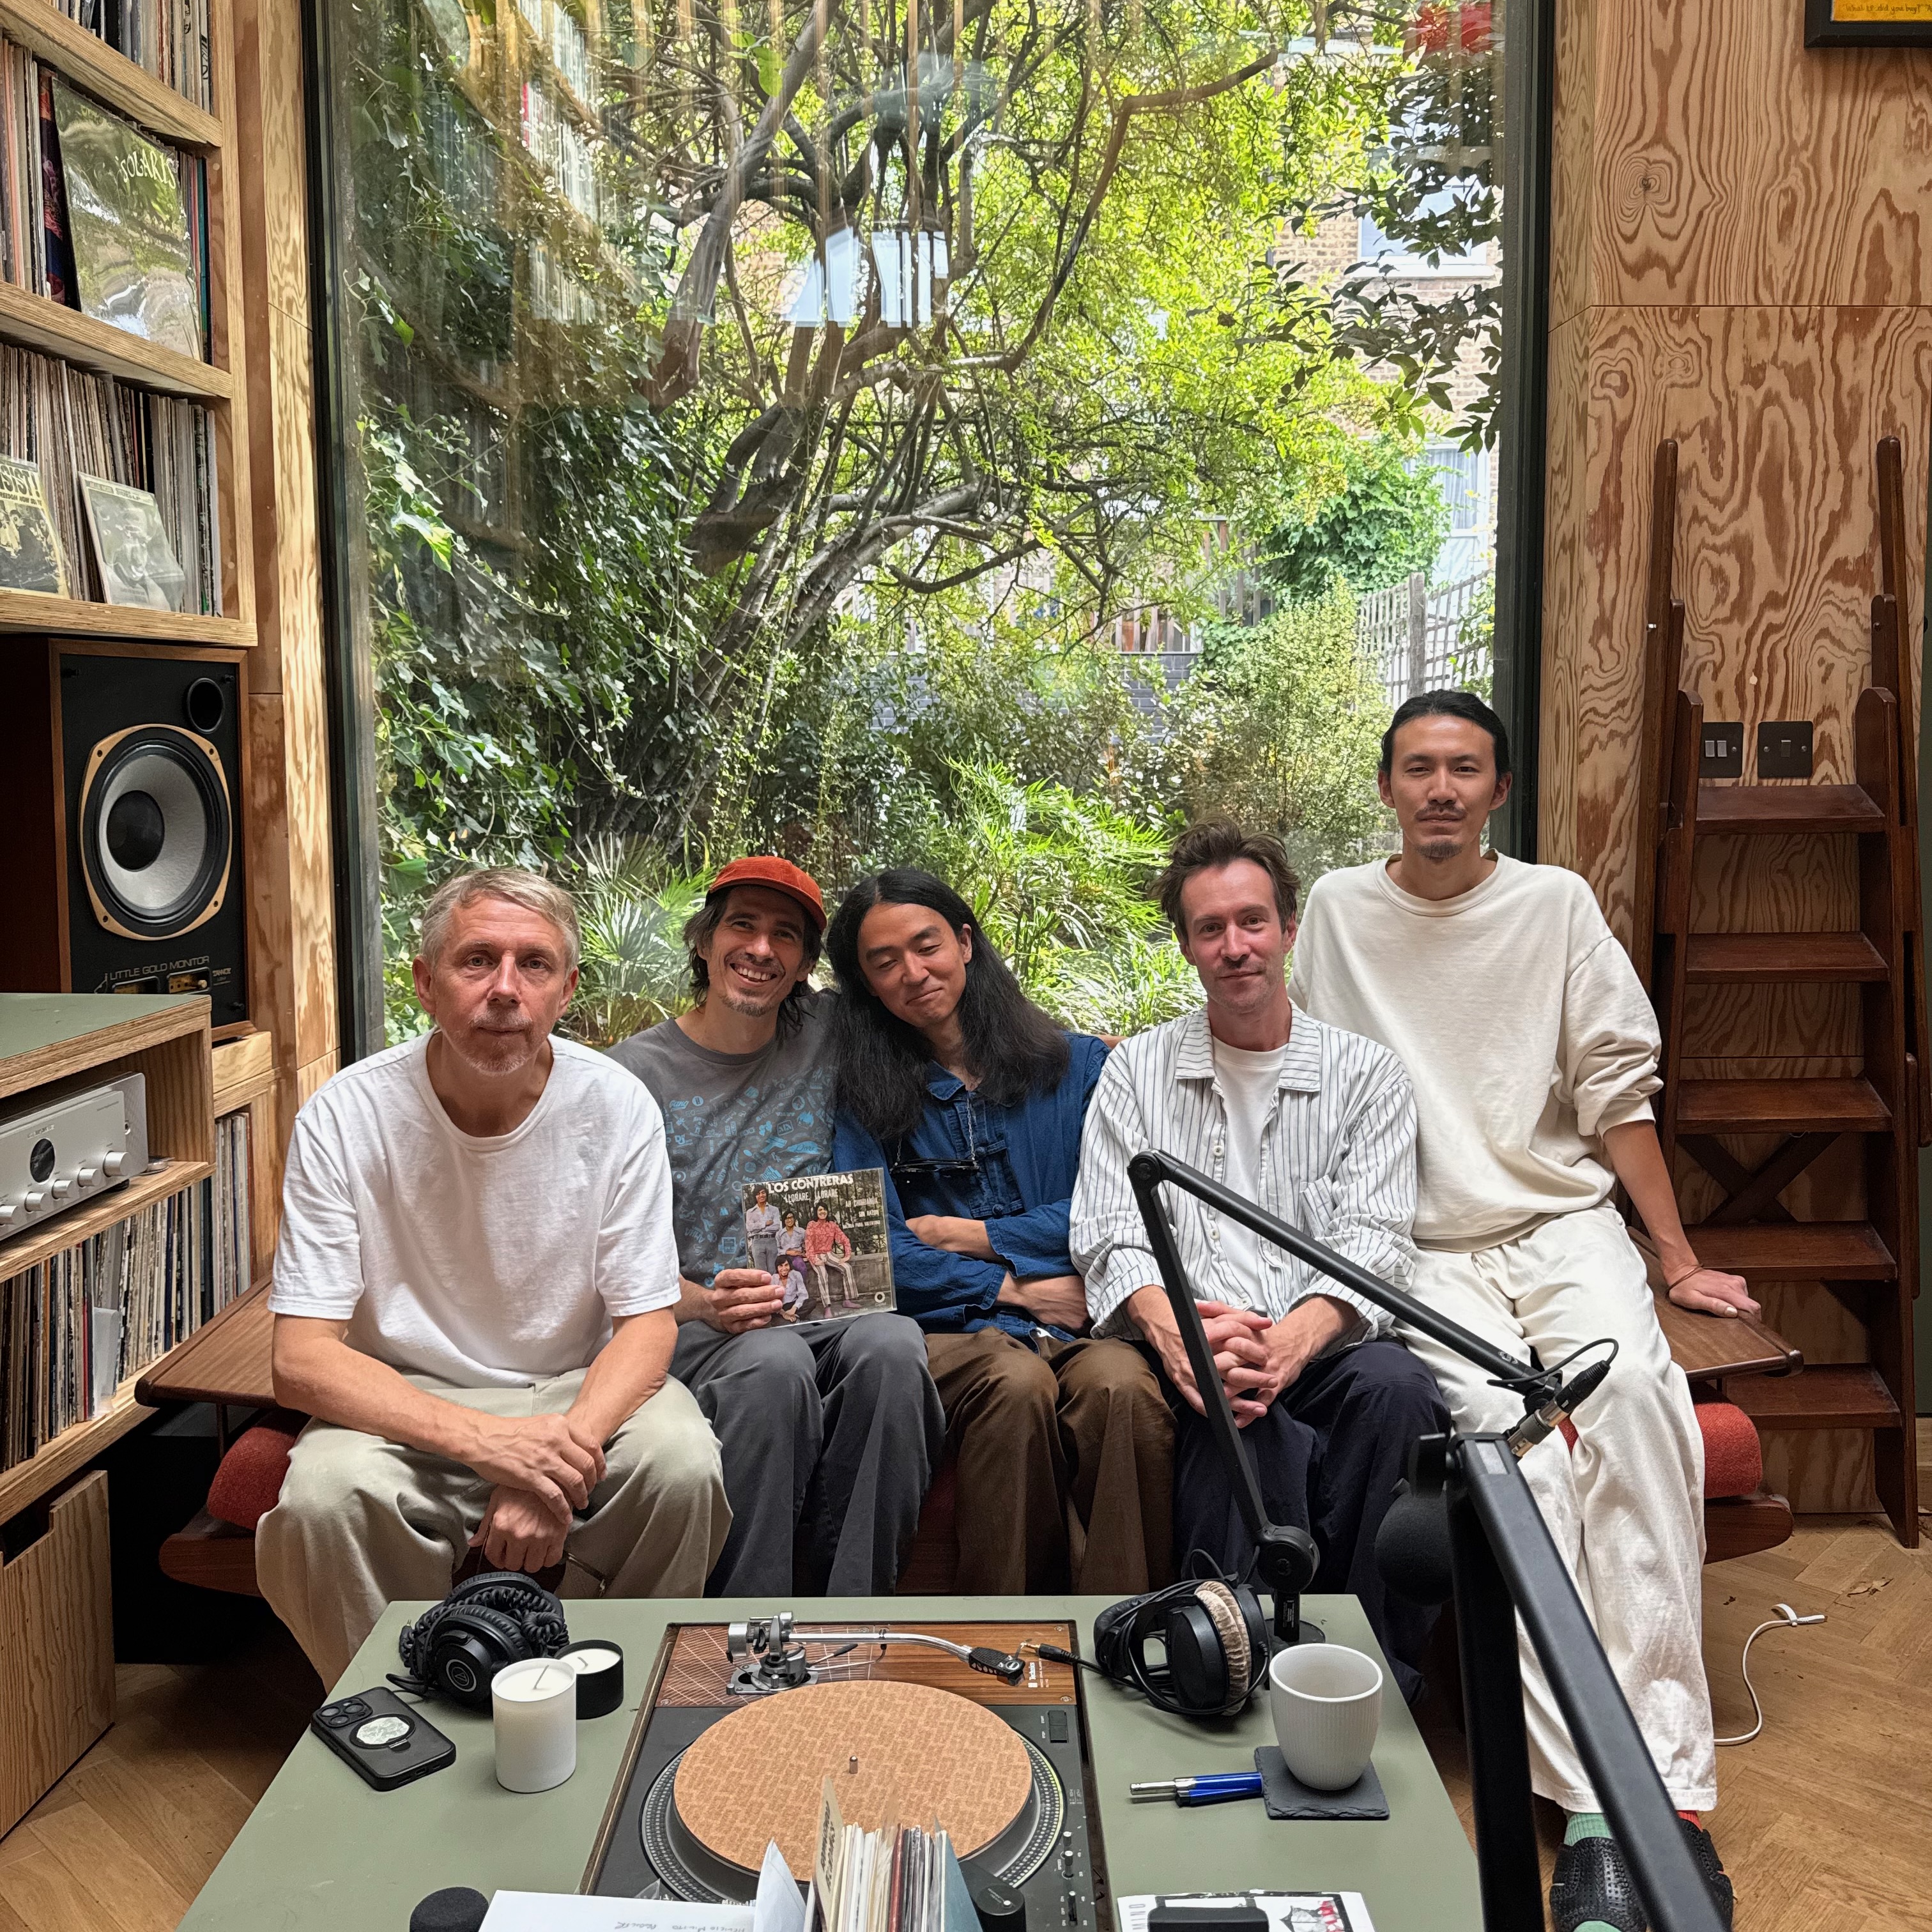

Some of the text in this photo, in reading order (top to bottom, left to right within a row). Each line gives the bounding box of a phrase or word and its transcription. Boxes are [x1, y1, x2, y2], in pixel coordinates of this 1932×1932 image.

[1890, 6, 1904, 15] you
[110, 956, 210, 980] LITTLE GOLD MONITOR
[767, 1181, 789, 1193] LOS
[792, 1174, 854, 1190] CONTRERAS
